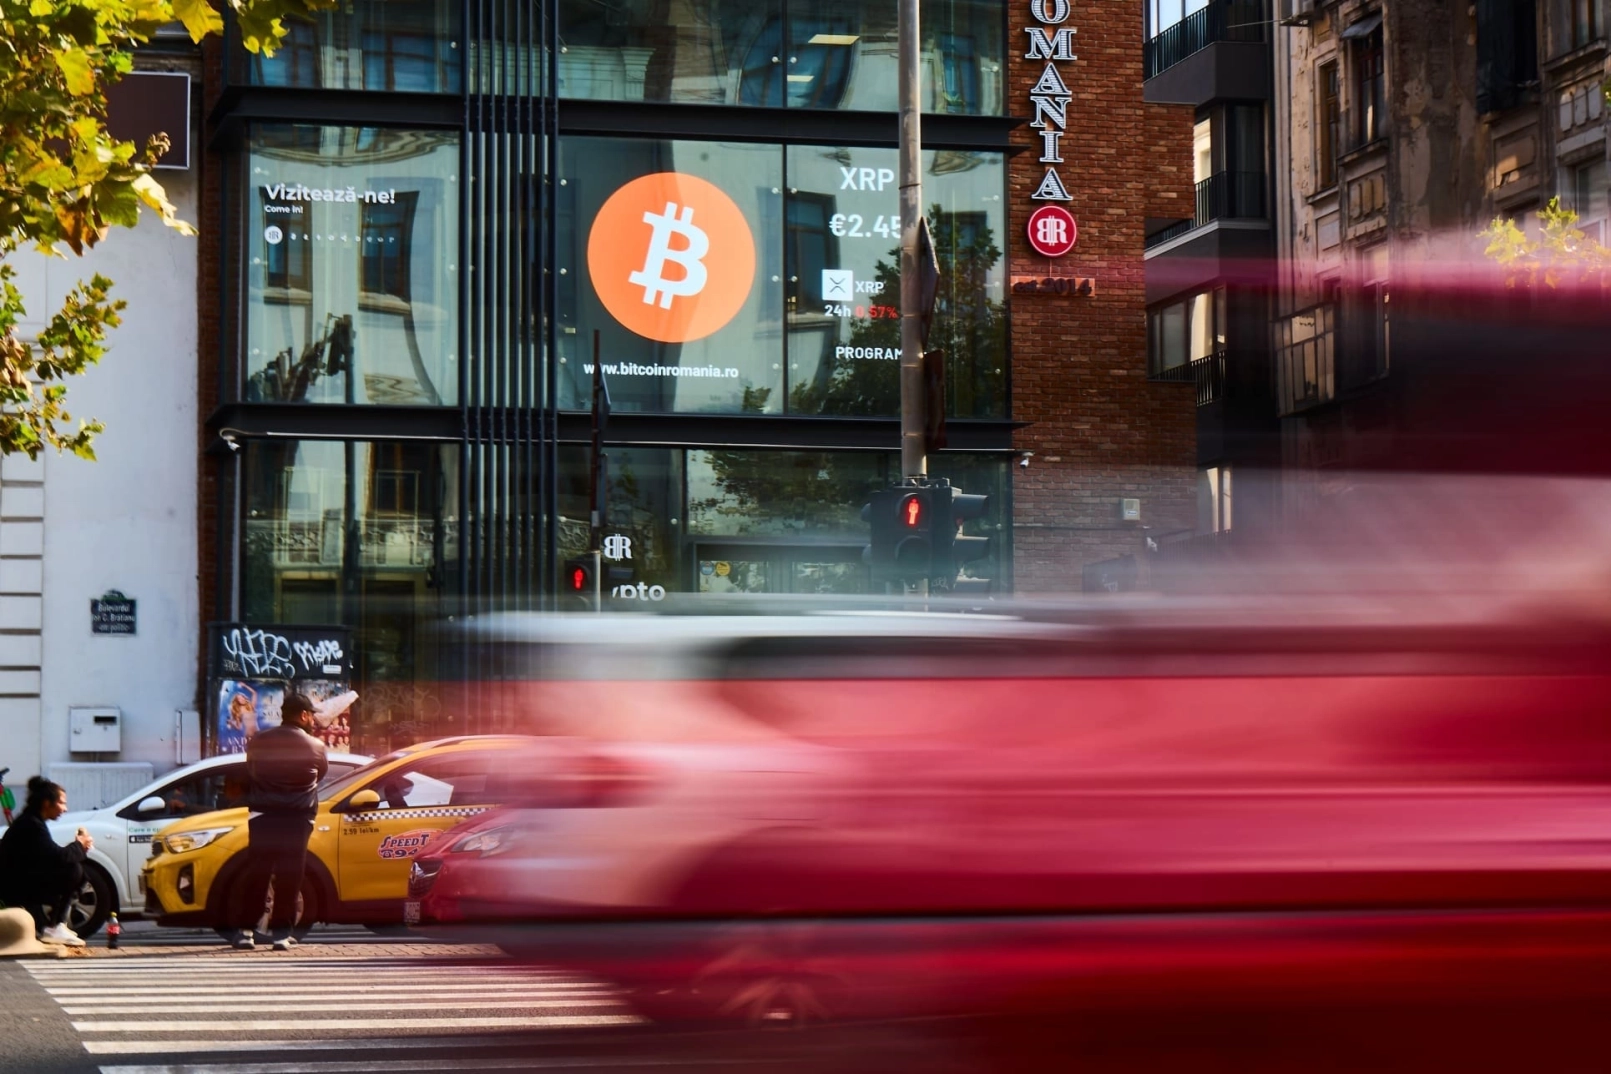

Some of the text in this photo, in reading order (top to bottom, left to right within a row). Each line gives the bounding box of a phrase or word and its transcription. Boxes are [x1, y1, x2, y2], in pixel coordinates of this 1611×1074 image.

[840, 166, 895, 192] XRP
[264, 183, 397, 204] Vizitează-ne!
[264, 204, 291, 213] Come
[855, 281, 885, 294] XRP
[824, 304, 852, 318] 24h
